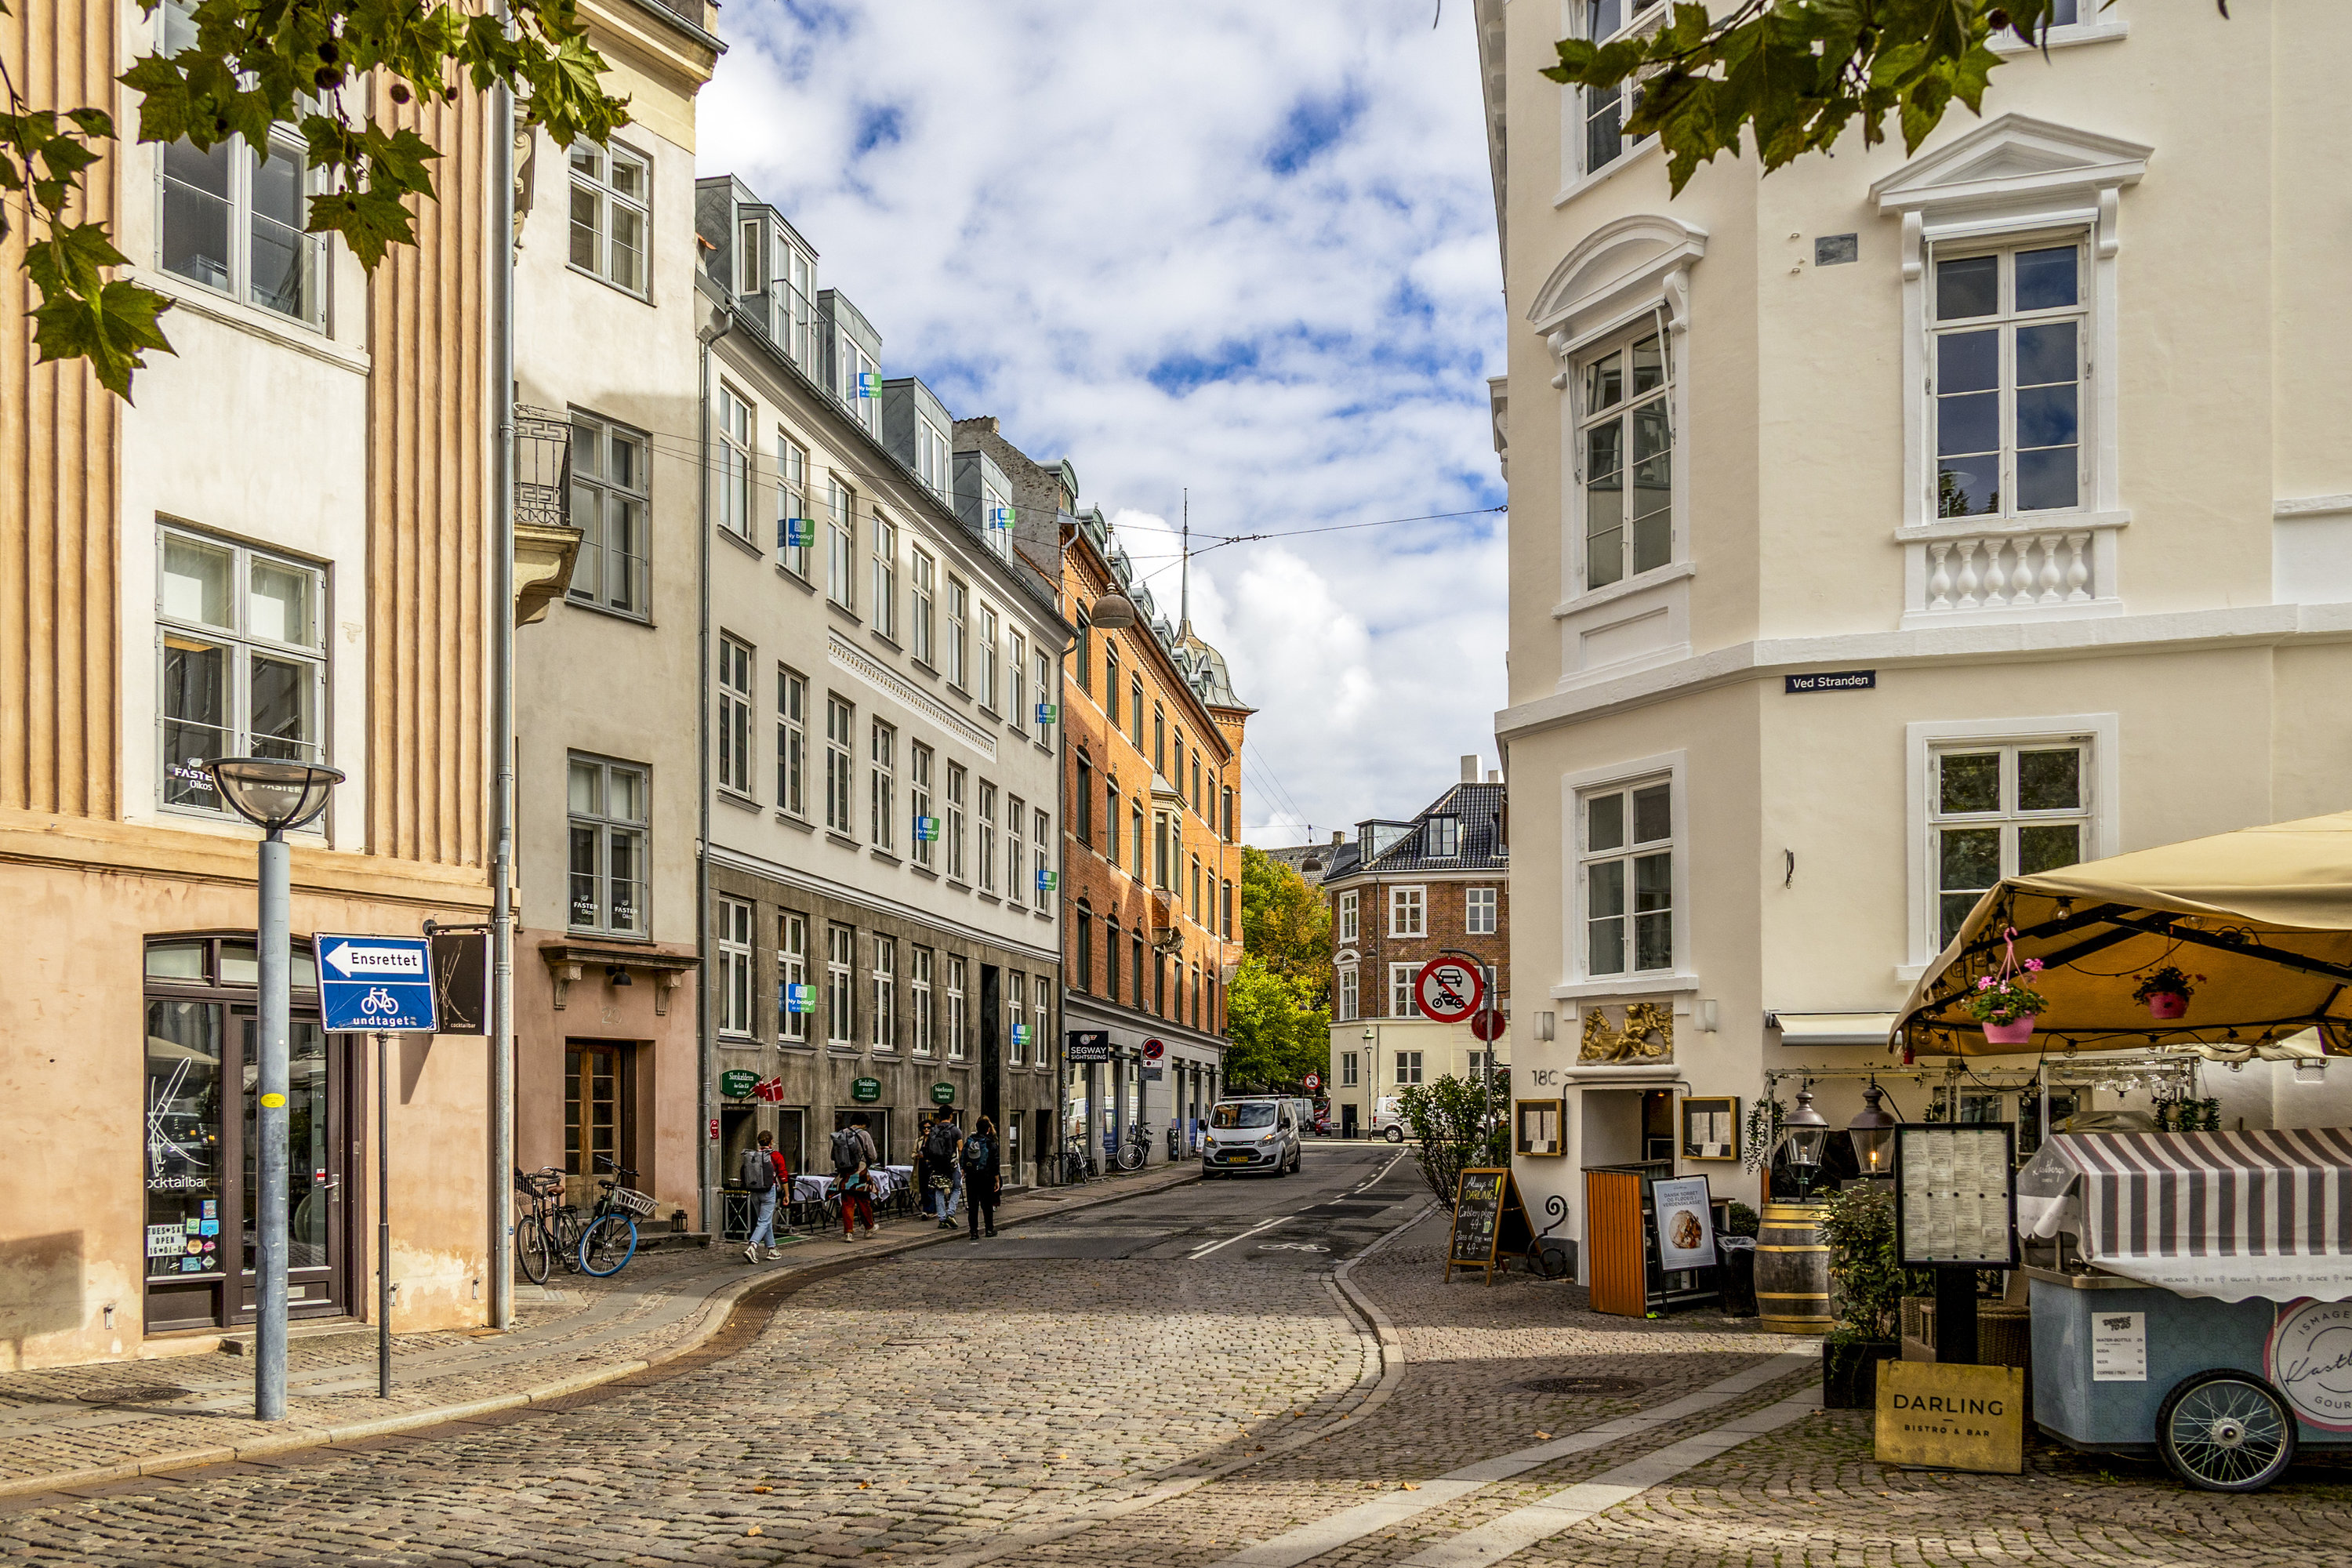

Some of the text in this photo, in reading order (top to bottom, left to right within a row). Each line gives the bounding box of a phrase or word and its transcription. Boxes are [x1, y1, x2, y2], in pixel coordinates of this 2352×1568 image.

[1793, 676, 1868, 688] Ved Stranden
[174, 767, 213, 782] FASTE
[190, 779, 213, 791] Oikos
[573, 902, 598, 910] FASTER
[615, 906, 638, 915] FASTER
[351, 953, 418, 966] Ensrettet
[353, 1016, 409, 1027] undtaget
[601, 1007, 622, 1025] 20
[1532, 1069, 1559, 1087] 18C
[147, 1175, 210, 1188] ocktailbar
[1465, 1176, 1486, 1191] Always
[1455, 1230, 1468, 1242] Glass
[2103, 1316, 2131, 1326] DRINKS
[2285, 1352, 2352, 1385] Kast
[1894, 1394, 2003, 1416] DARLING
[1904, 1424, 1947, 1435] BISTRO
